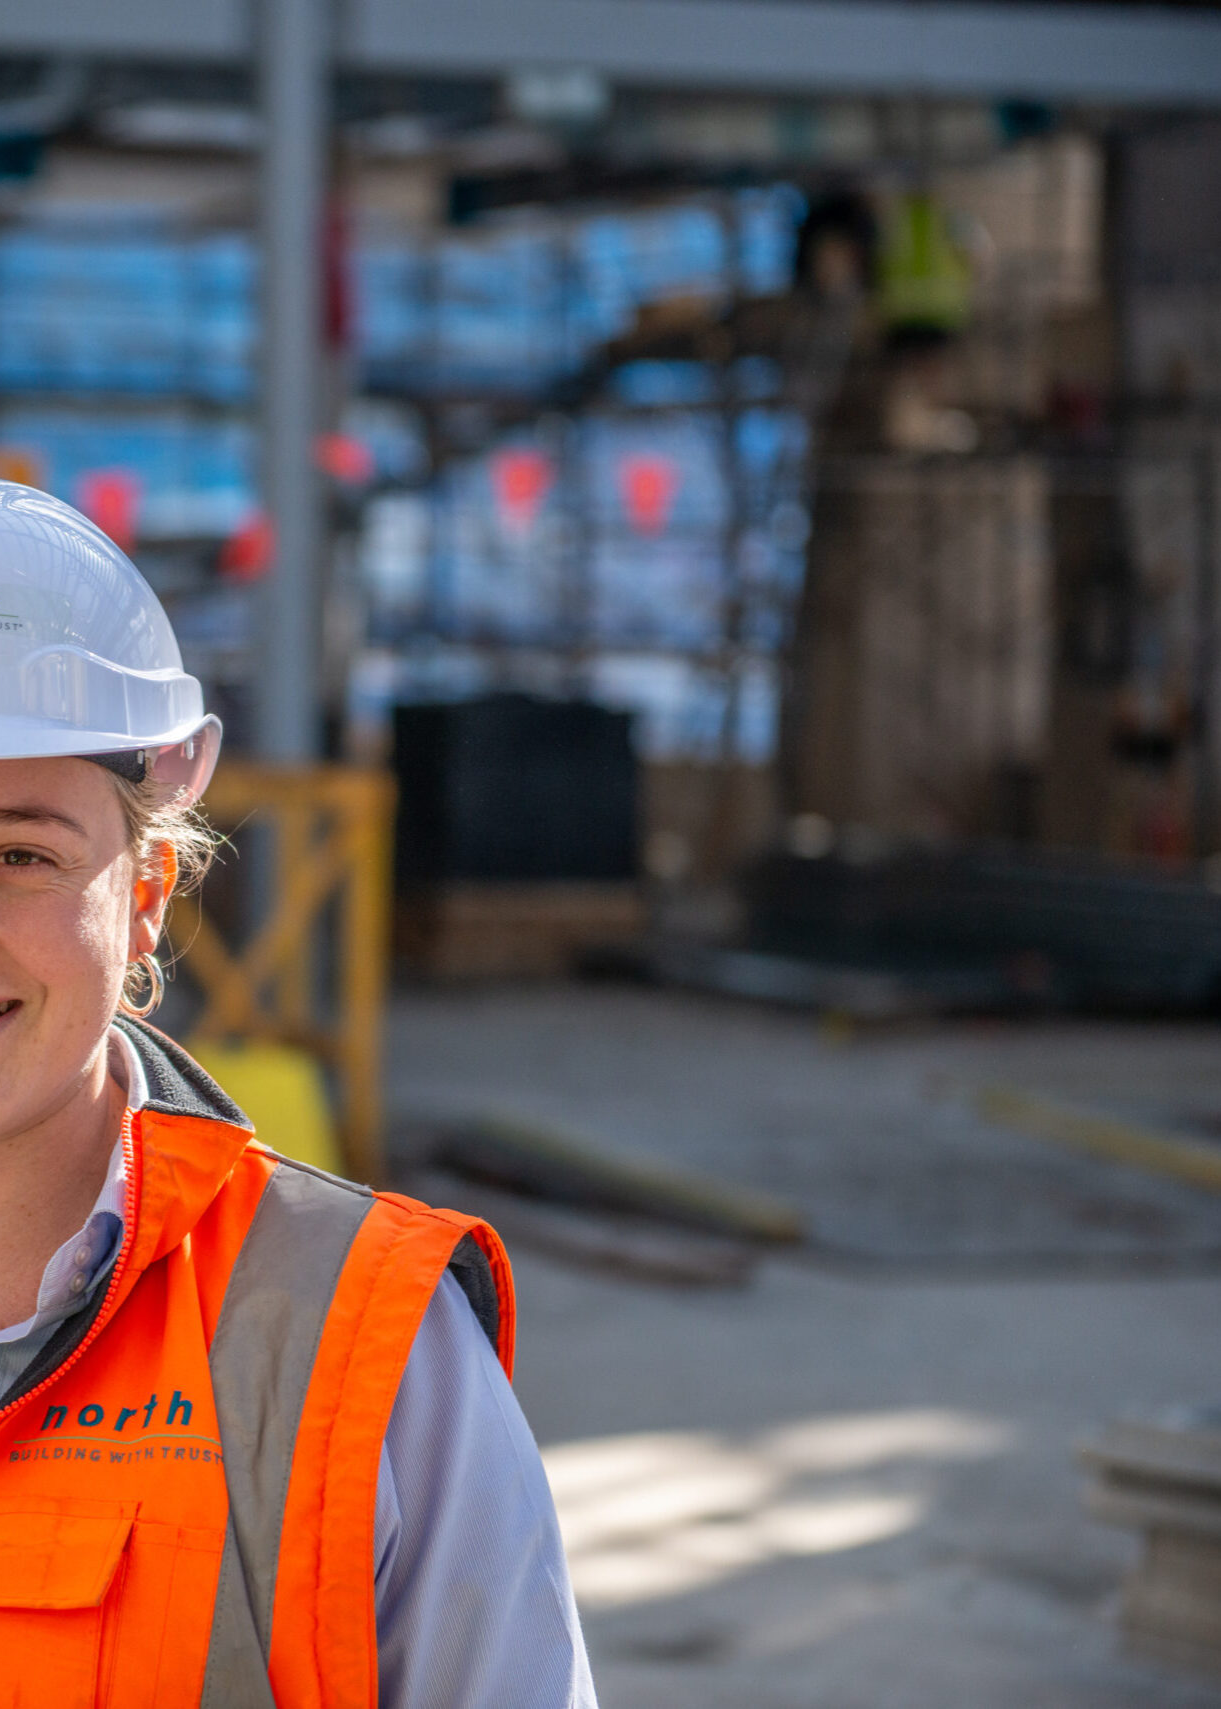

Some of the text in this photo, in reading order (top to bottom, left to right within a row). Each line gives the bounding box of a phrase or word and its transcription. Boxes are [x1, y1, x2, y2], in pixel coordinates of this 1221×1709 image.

[41, 1390, 193, 1432] north
[9, 1447, 101, 1463] BUILDING
[110, 1447, 154, 1464] WITH
